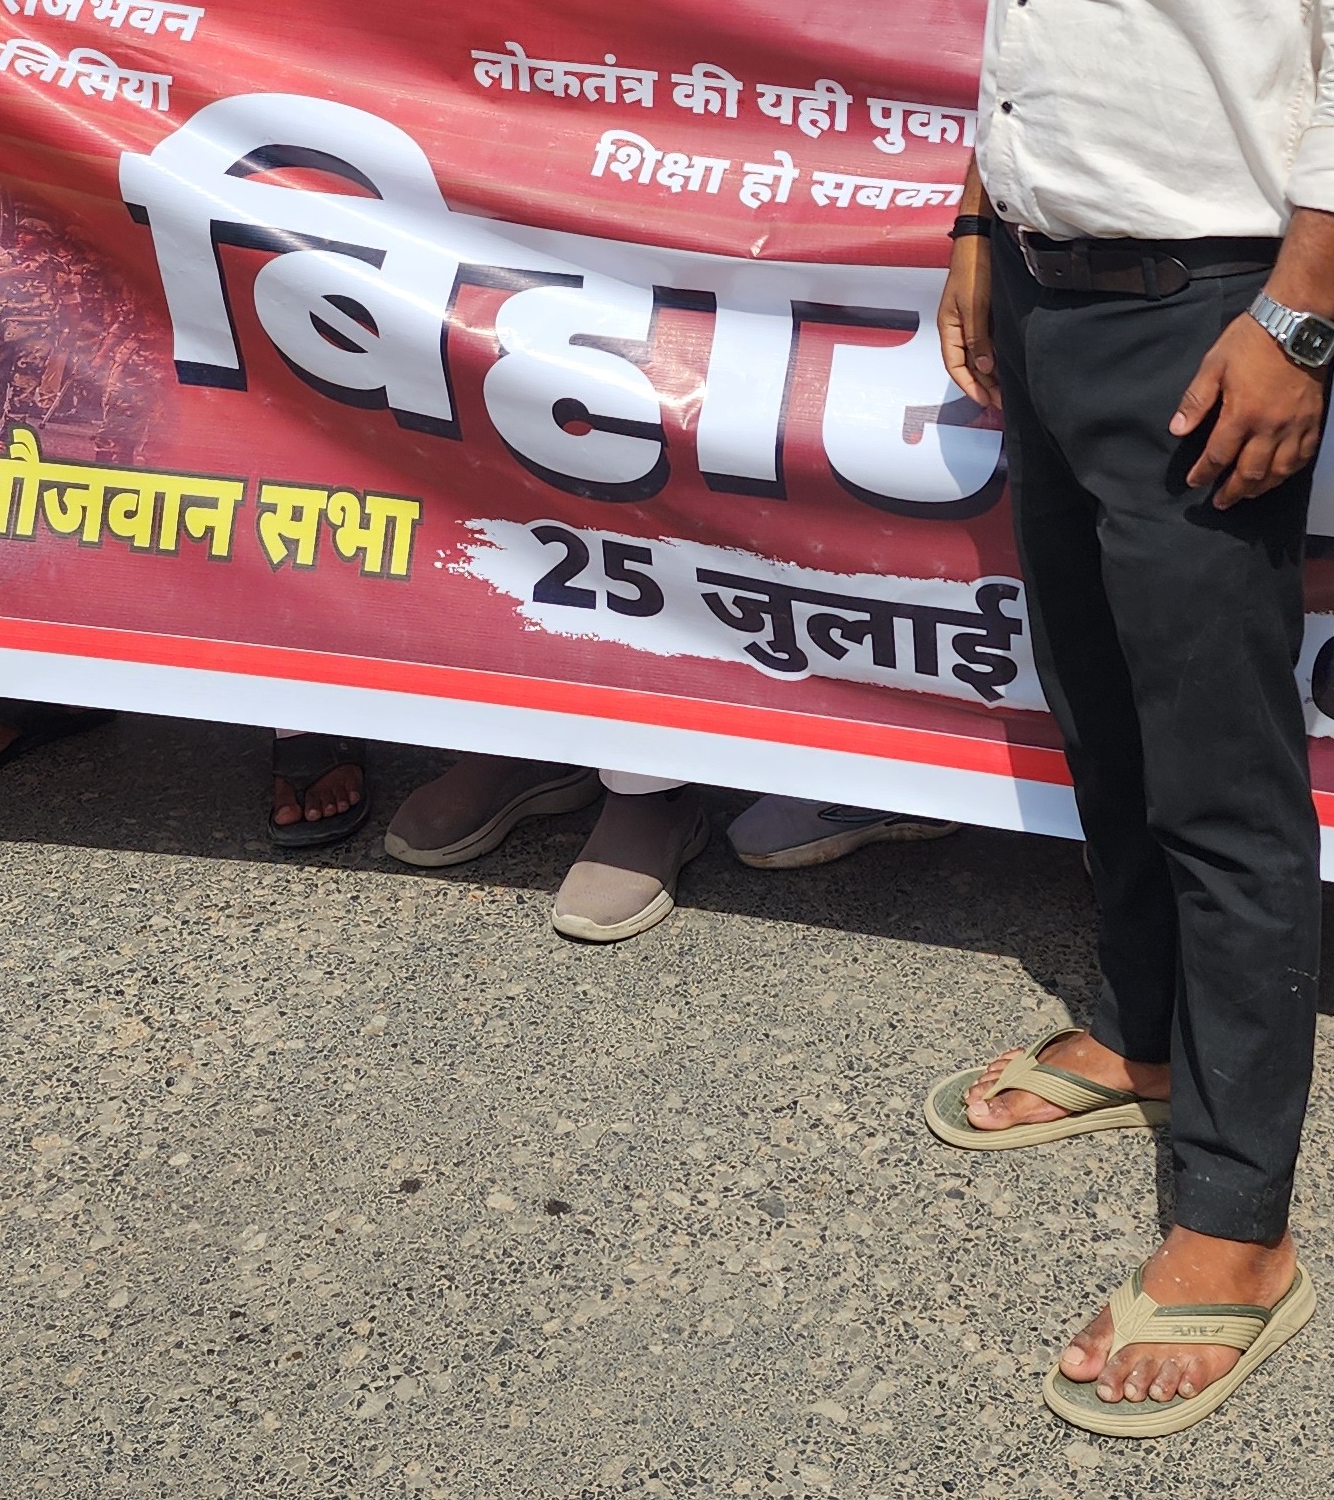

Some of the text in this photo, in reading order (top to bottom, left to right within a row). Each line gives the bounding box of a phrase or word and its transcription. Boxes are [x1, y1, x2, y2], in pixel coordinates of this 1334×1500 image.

[470, 40, 980, 155] लोकतंत्र की यही पुका
[589, 129, 731, 195] शिक्षा
[739, 150, 799, 210] हो
[260, 483, 421, 576] सभा
[529, 524, 1024, 703] 25 जुलाई
